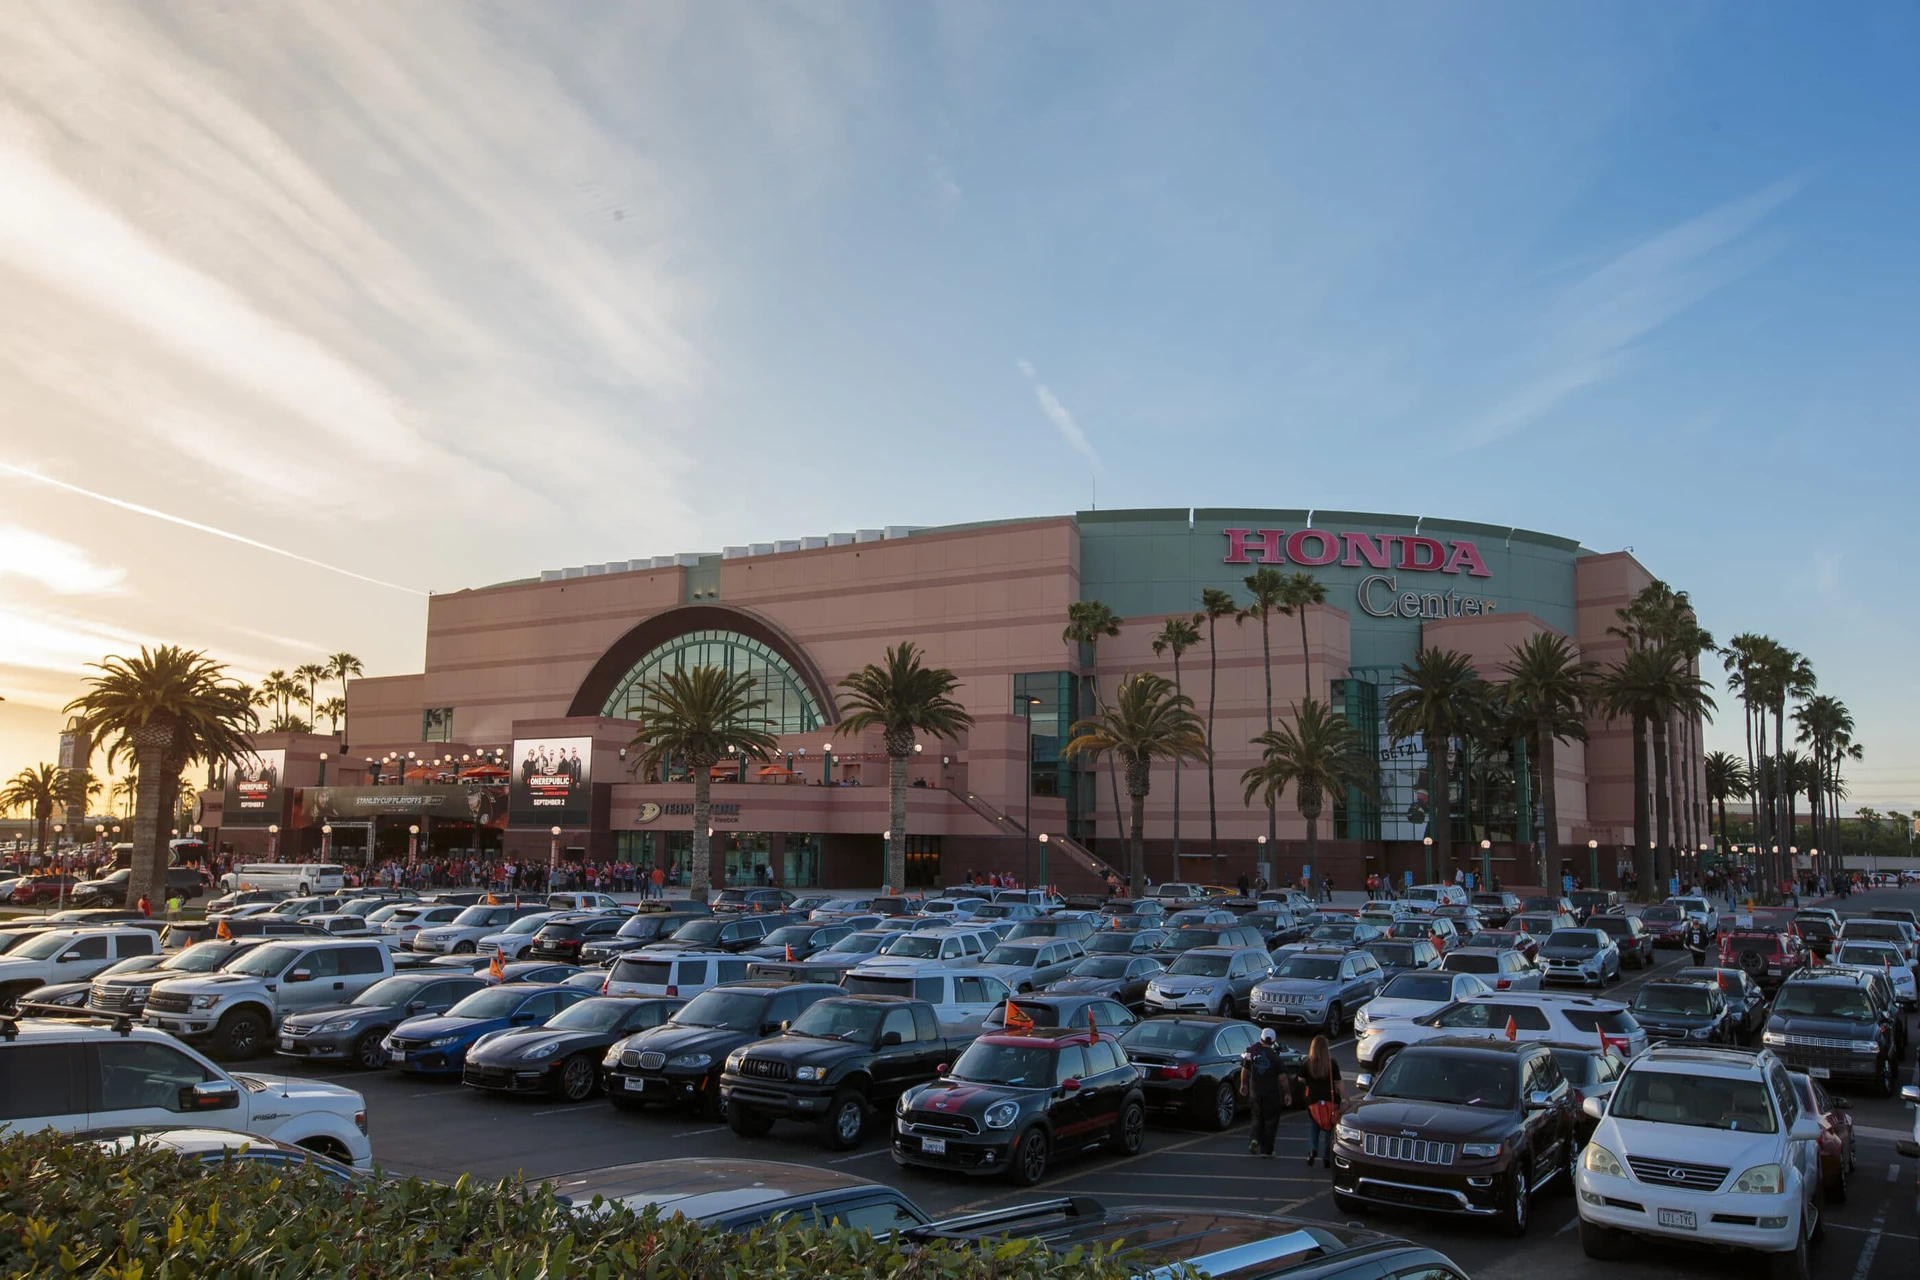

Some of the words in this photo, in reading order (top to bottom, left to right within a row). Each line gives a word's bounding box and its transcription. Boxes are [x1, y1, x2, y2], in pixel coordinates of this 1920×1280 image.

[1223, 528, 1493, 577] HONDA
[1357, 574, 1497, 619] Center
[1380, 742, 1425, 761] GETZL
[530, 777, 570, 785] ONEREPUBLIC
[356, 797, 381, 805] STANLEY
[381, 797, 393, 805] CUP
[392, 796, 422, 804] PLAYOFFS
[663, 803, 694, 815] TEAM
[709, 804, 740, 815] TORE
[714, 816, 740, 824] Reebok
[1693, 934, 1700, 944] 9
[1400, 1129, 1418, 1138] Jeep
[1662, 1212, 1694, 1226] 171-TYC
